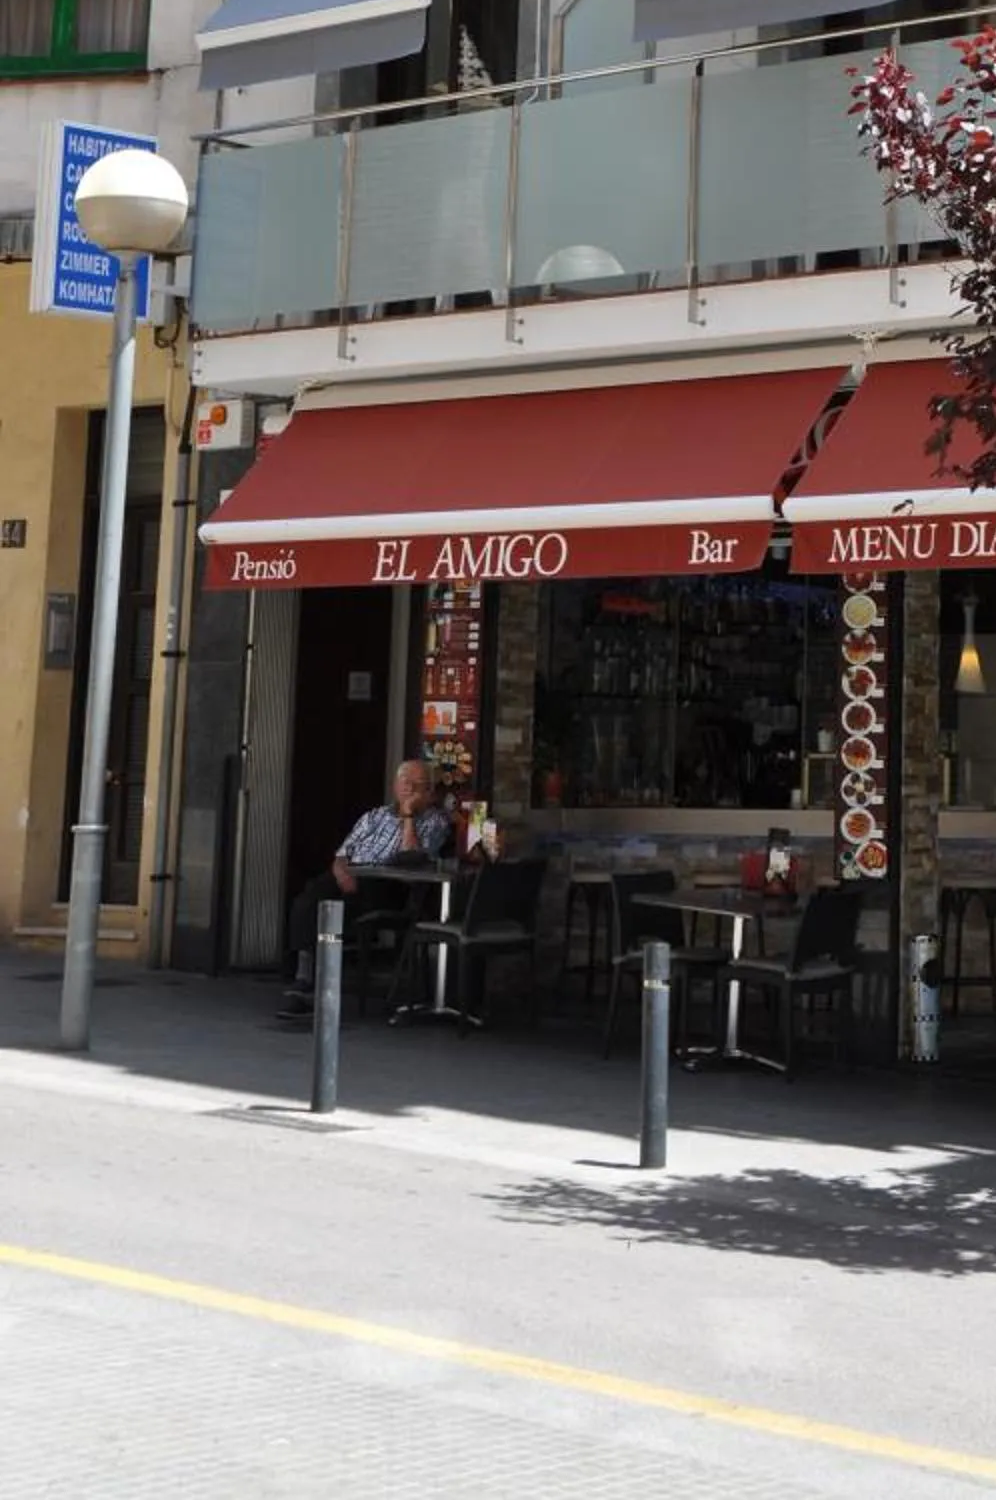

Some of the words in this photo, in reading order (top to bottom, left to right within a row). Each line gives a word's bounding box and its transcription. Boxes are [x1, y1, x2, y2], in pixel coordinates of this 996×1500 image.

[60, 251, 110, 277] ZIMMER
[231, 549, 297, 581] Pensió
[372, 539, 418, 581] EL
[428, 532, 568, 579] AMIGO
[688, 528, 739, 565] Bar
[827, 523, 939, 563] MENU
